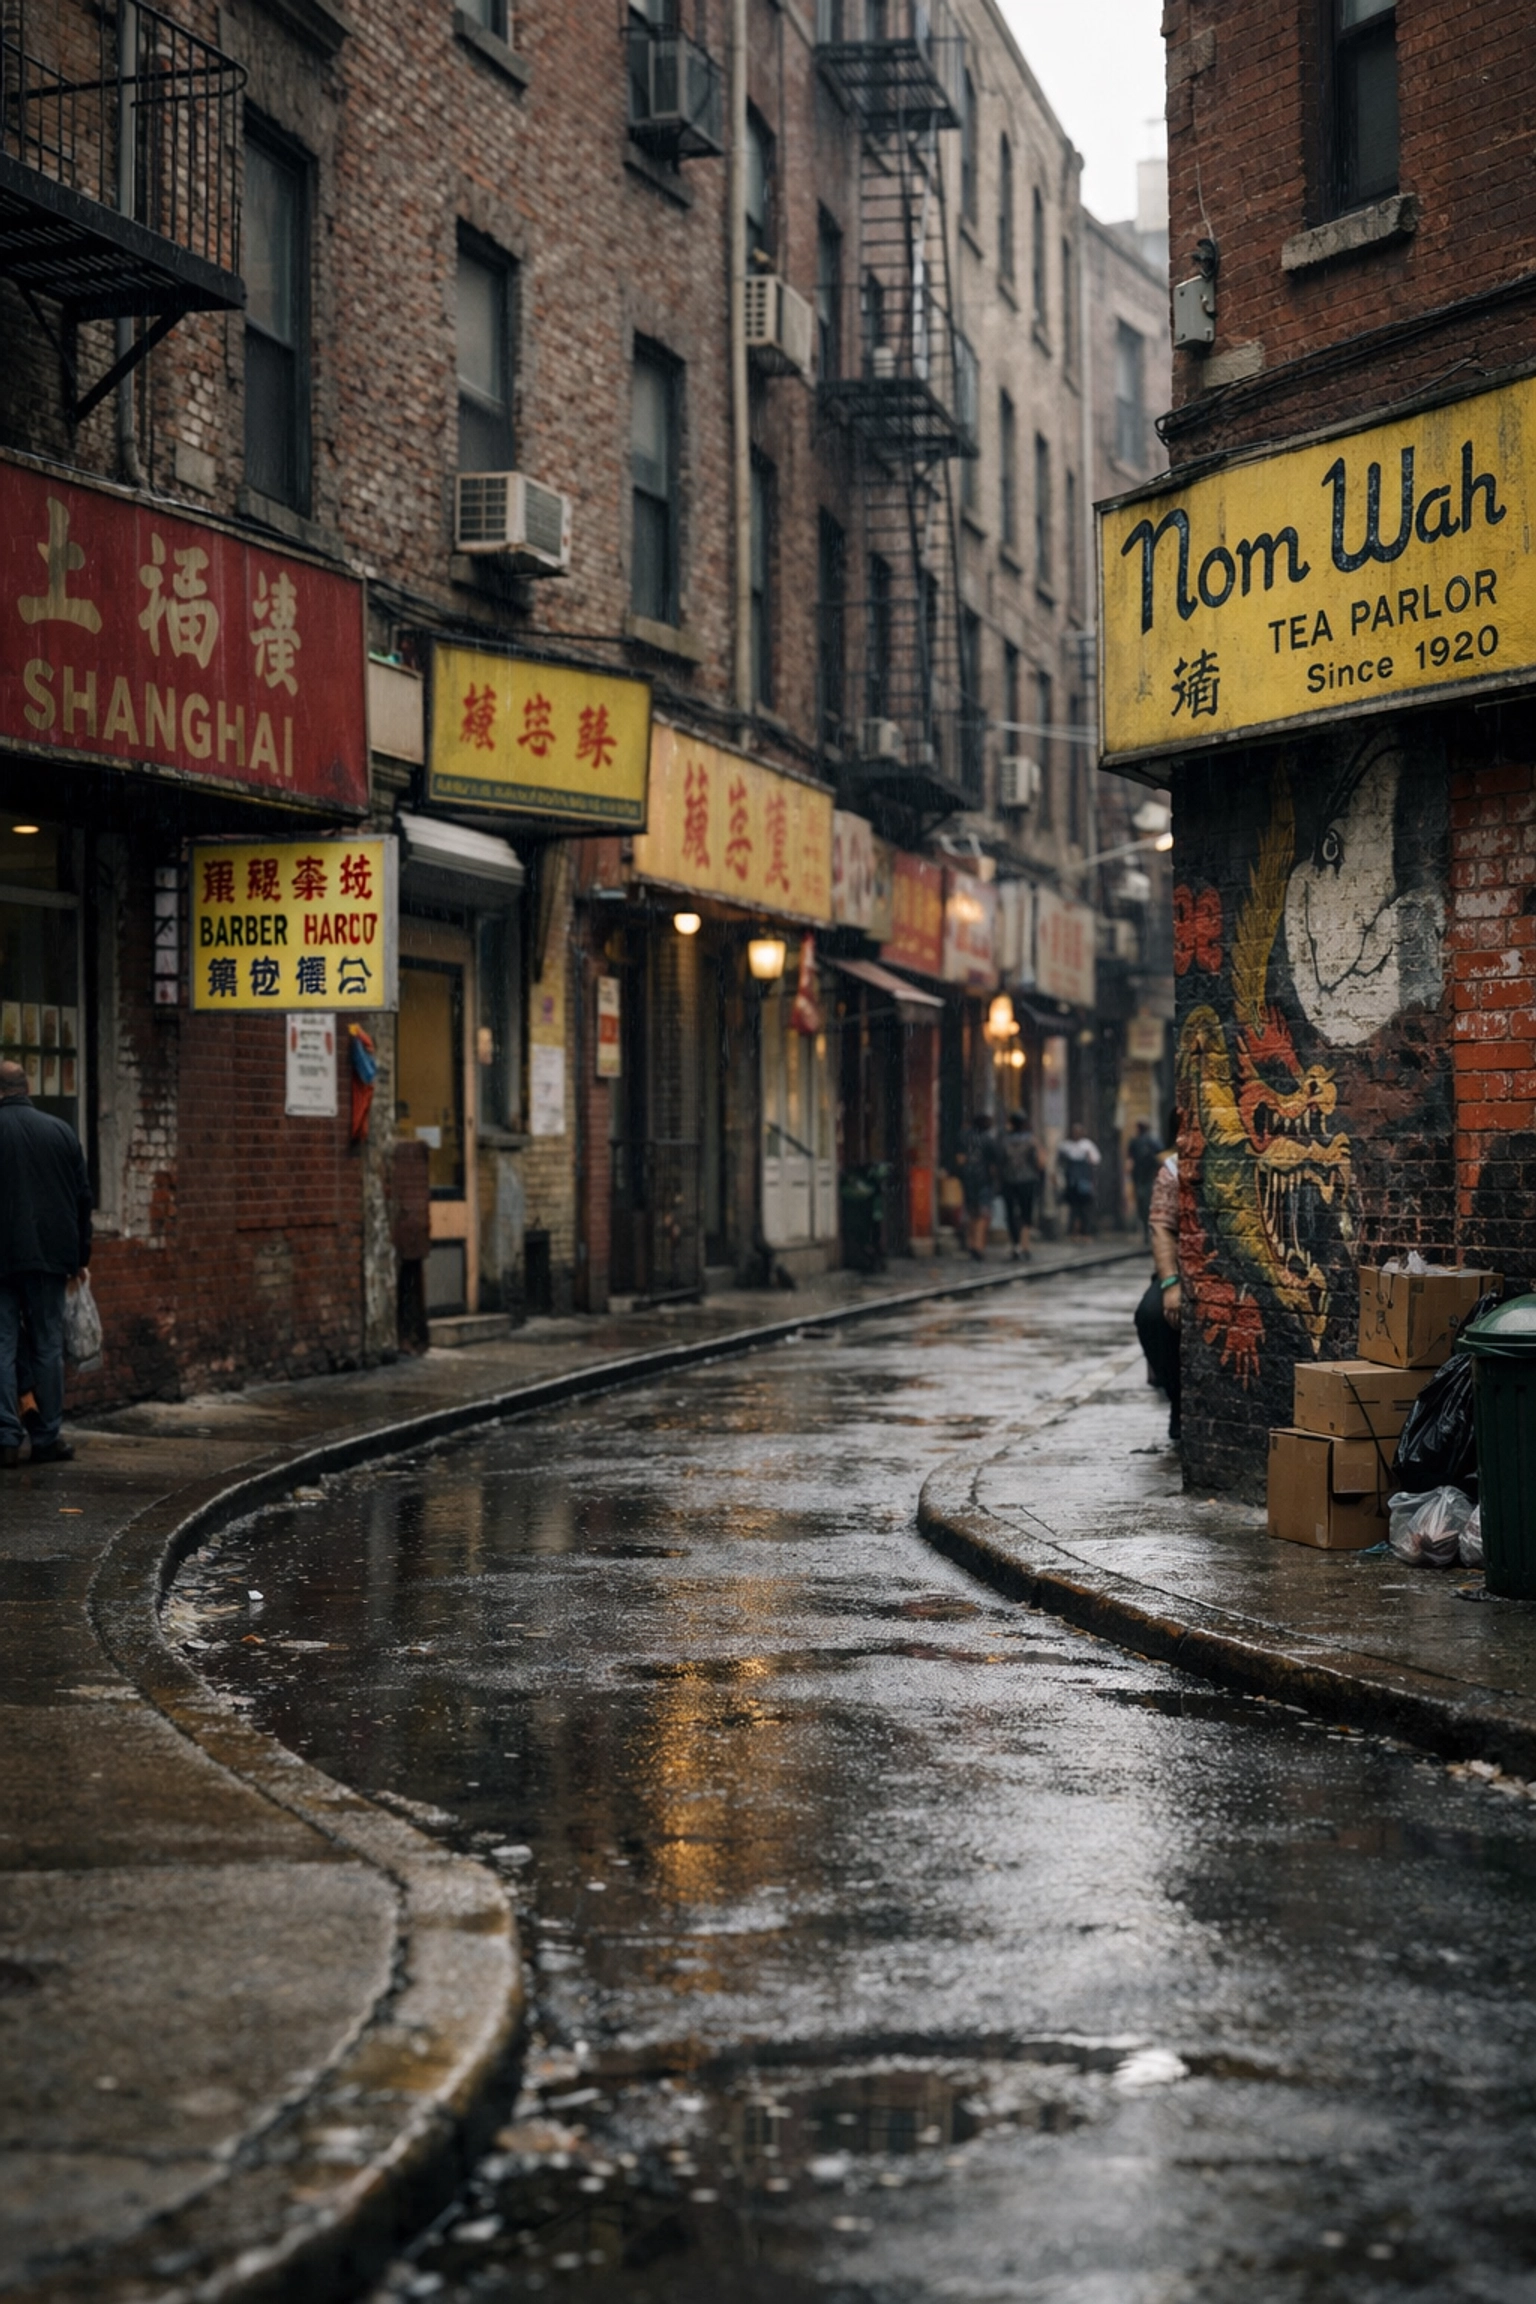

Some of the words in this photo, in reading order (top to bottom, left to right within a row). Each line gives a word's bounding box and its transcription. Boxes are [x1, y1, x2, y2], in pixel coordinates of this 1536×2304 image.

[1120, 508, 1311, 636] Nom
[1321, 440, 1507, 573] Wah
[1268, 609, 1333, 654] TEA
[1350, 568, 1498, 636] PARLOR
[1306, 655, 1394, 694] Since
[1415, 624, 1499, 670] 1920
[23, 658, 294, 778] SHANGHAI
[200, 914, 288, 948] BARBER
